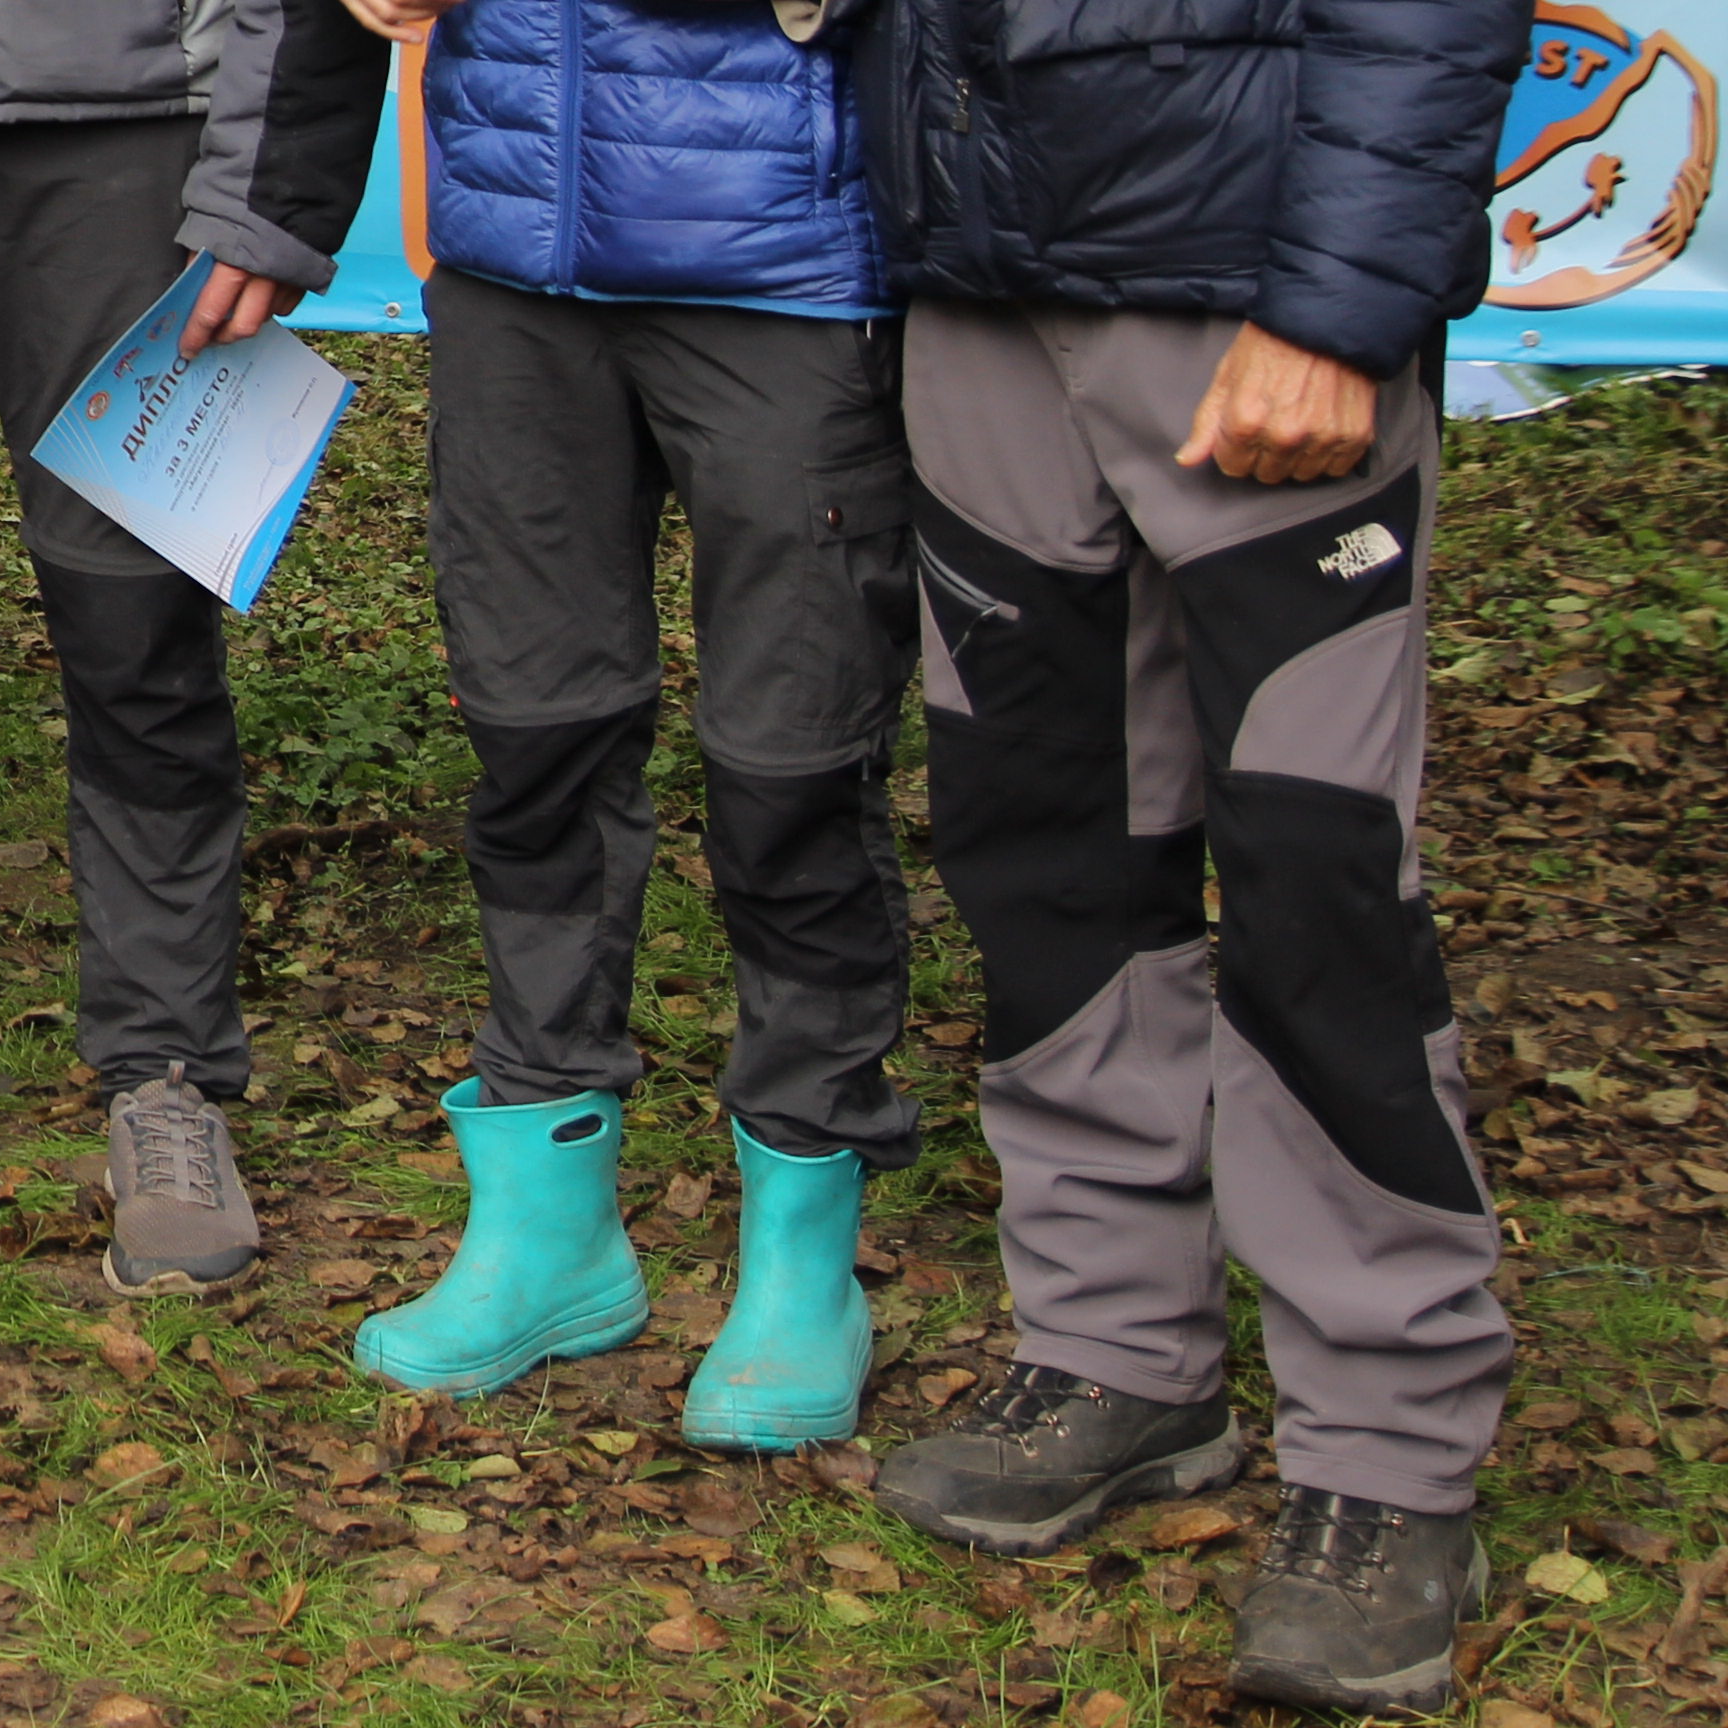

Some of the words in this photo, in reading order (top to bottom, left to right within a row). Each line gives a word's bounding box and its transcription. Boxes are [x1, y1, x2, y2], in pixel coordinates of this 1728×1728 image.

[1534, 38, 1611, 90] ST
[121, 355, 191, 462] ДИПЛО
[165, 455, 182, 478] за
[177, 438, 190, 453] 3
[185, 366, 230, 437] МЕСТО
